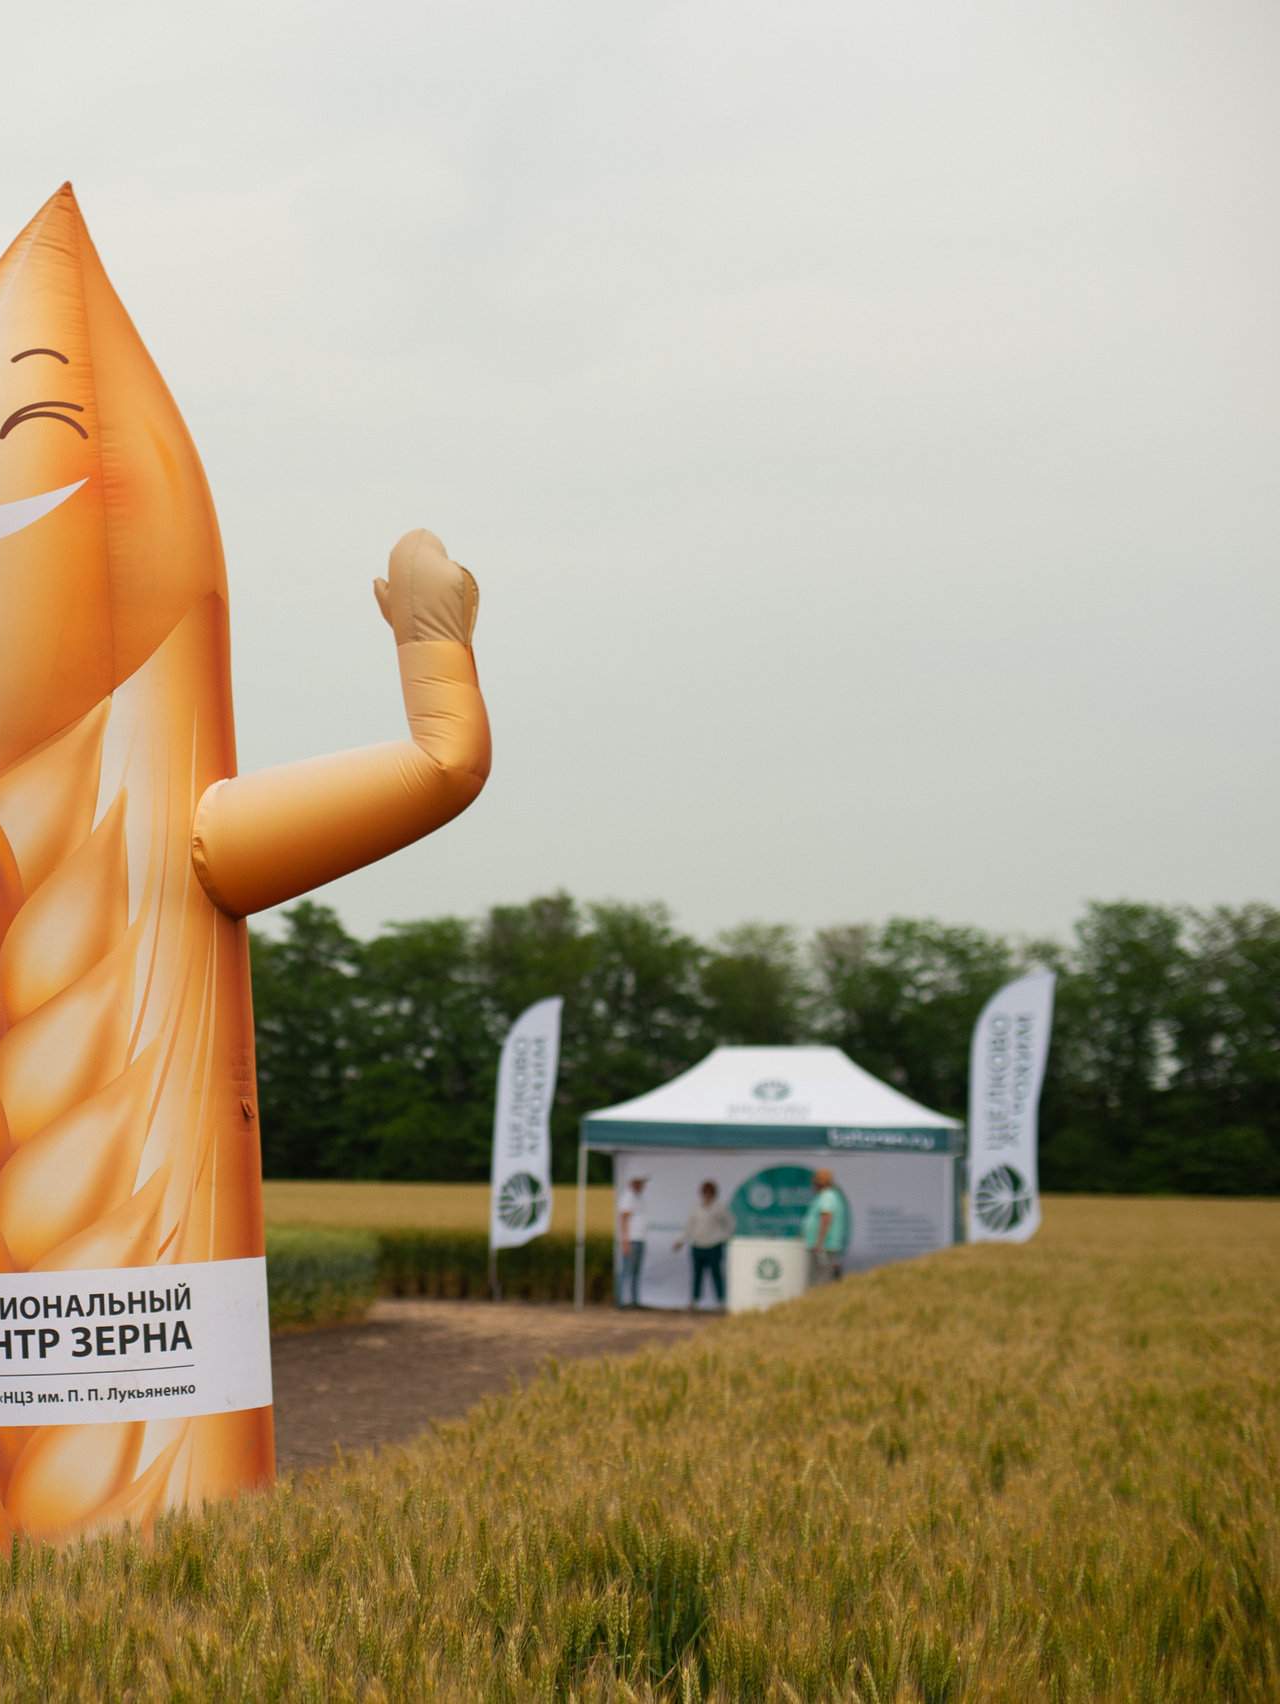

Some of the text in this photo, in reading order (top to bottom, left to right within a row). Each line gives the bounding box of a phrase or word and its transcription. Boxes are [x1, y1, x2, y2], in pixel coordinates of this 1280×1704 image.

[71, 1320, 193, 1357] ЗЕРНА
[37, 1392, 64, 1404] им.
[67, 1389, 84, 1402] П.
[87, 1388, 104, 1401] П.
[107, 1384, 196, 1403] Лукьяненко
